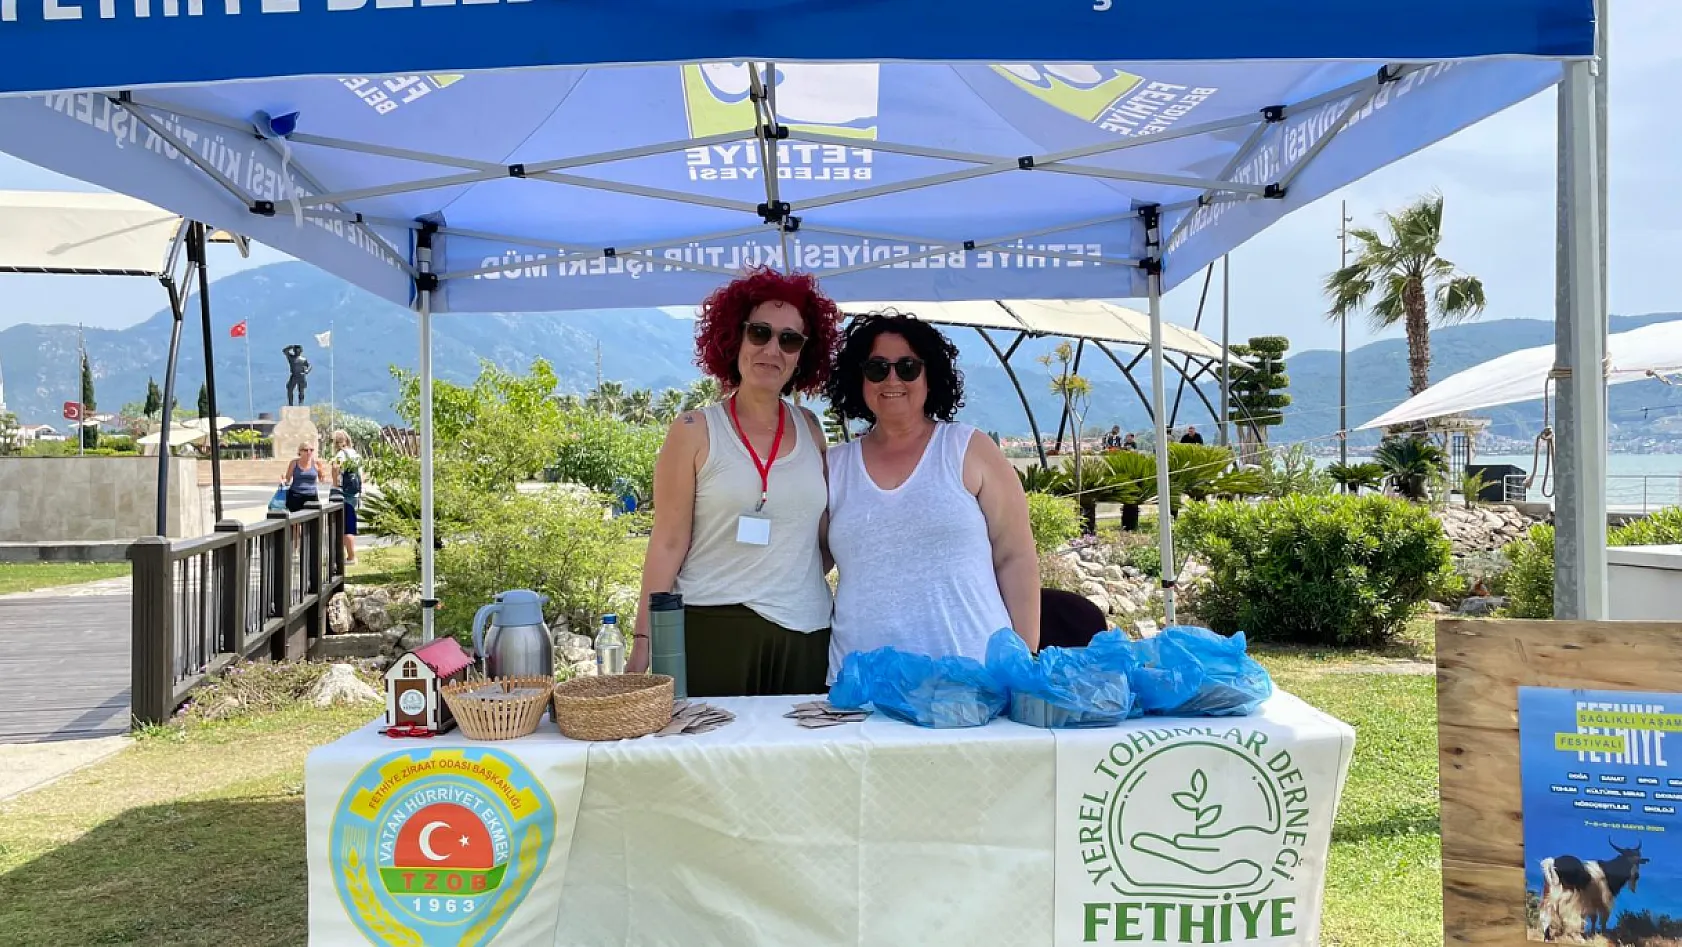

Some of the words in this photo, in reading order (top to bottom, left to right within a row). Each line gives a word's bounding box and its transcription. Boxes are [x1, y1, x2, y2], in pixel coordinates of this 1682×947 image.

[1094, 727, 1269, 780] TOHUMLAR
[369, 774, 402, 810] FETHİYE
[402, 760, 436, 778] ZİRAAT
[438, 758, 471, 770] ODASI
[472, 763, 522, 810] BAŞKANLIĞI
[380, 809, 406, 862] VATAN
[405, 785, 484, 811] HÜRRİYET
[481, 808, 508, 861] EKMEK
[1079, 790, 1112, 886] YEREL
[1267, 749, 1310, 882] DERNEĞİ
[413, 897, 475, 912] 1963
[1083, 893, 1297, 943] FETHİYE
